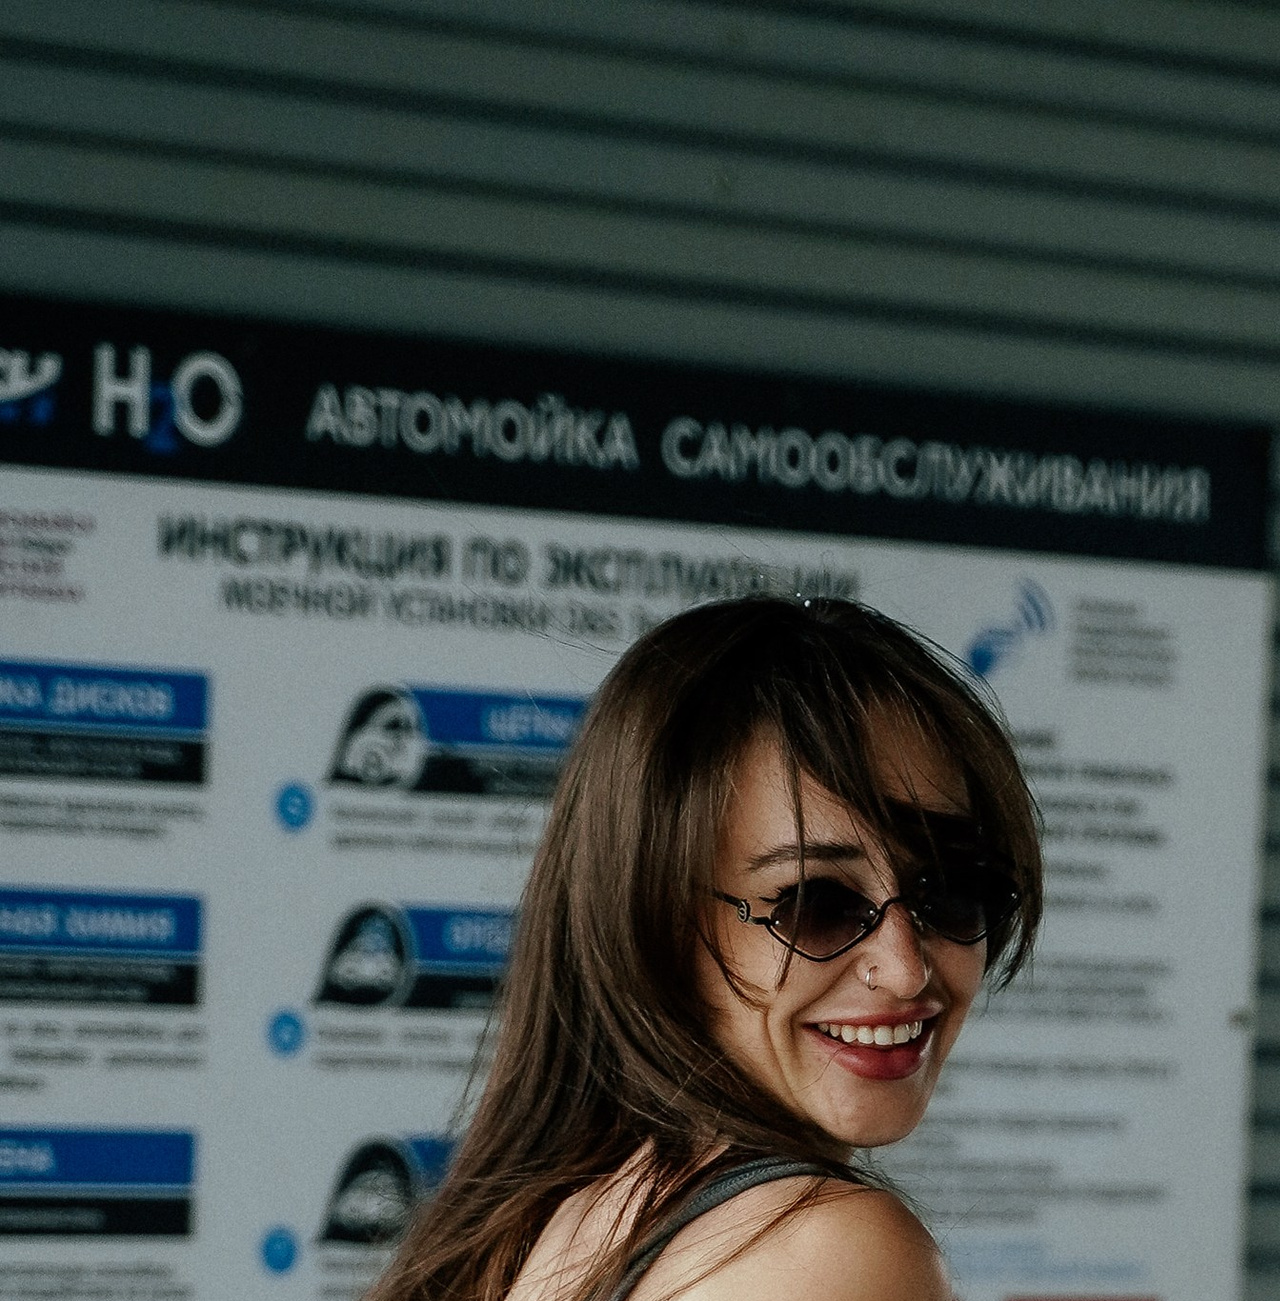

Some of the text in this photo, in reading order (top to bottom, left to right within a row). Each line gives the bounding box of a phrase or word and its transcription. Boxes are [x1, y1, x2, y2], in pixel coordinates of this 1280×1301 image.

[306, 382, 1211, 523] АВТОМОЙКА САМООБСЛУЖИВАНИЯ
[158, 513, 453, 581] ИНСТРУКЦИЯ
[462, 534, 530, 589] ПО
